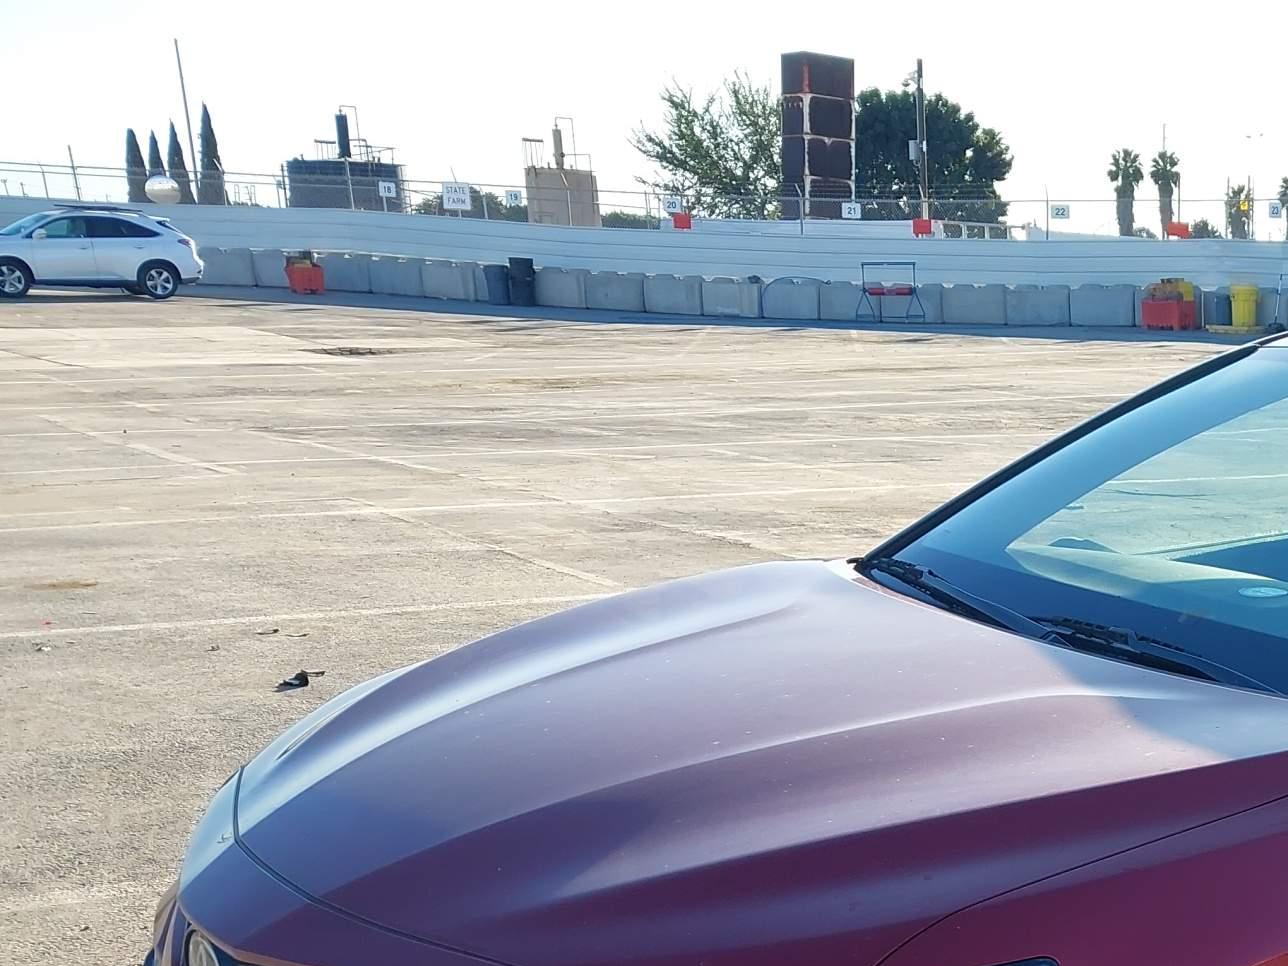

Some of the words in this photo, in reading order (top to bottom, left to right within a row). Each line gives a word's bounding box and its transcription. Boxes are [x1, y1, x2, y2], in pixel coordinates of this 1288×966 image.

[445, 185, 467, 196] STATE
[446, 196, 467, 206] FARM
[509, 192, 518, 202] 19
[666, 199, 677, 210] 20
[847, 206, 857, 216] 21
[1054, 207, 1066, 217] 22
[1271, 205, 1280, 215] 23
